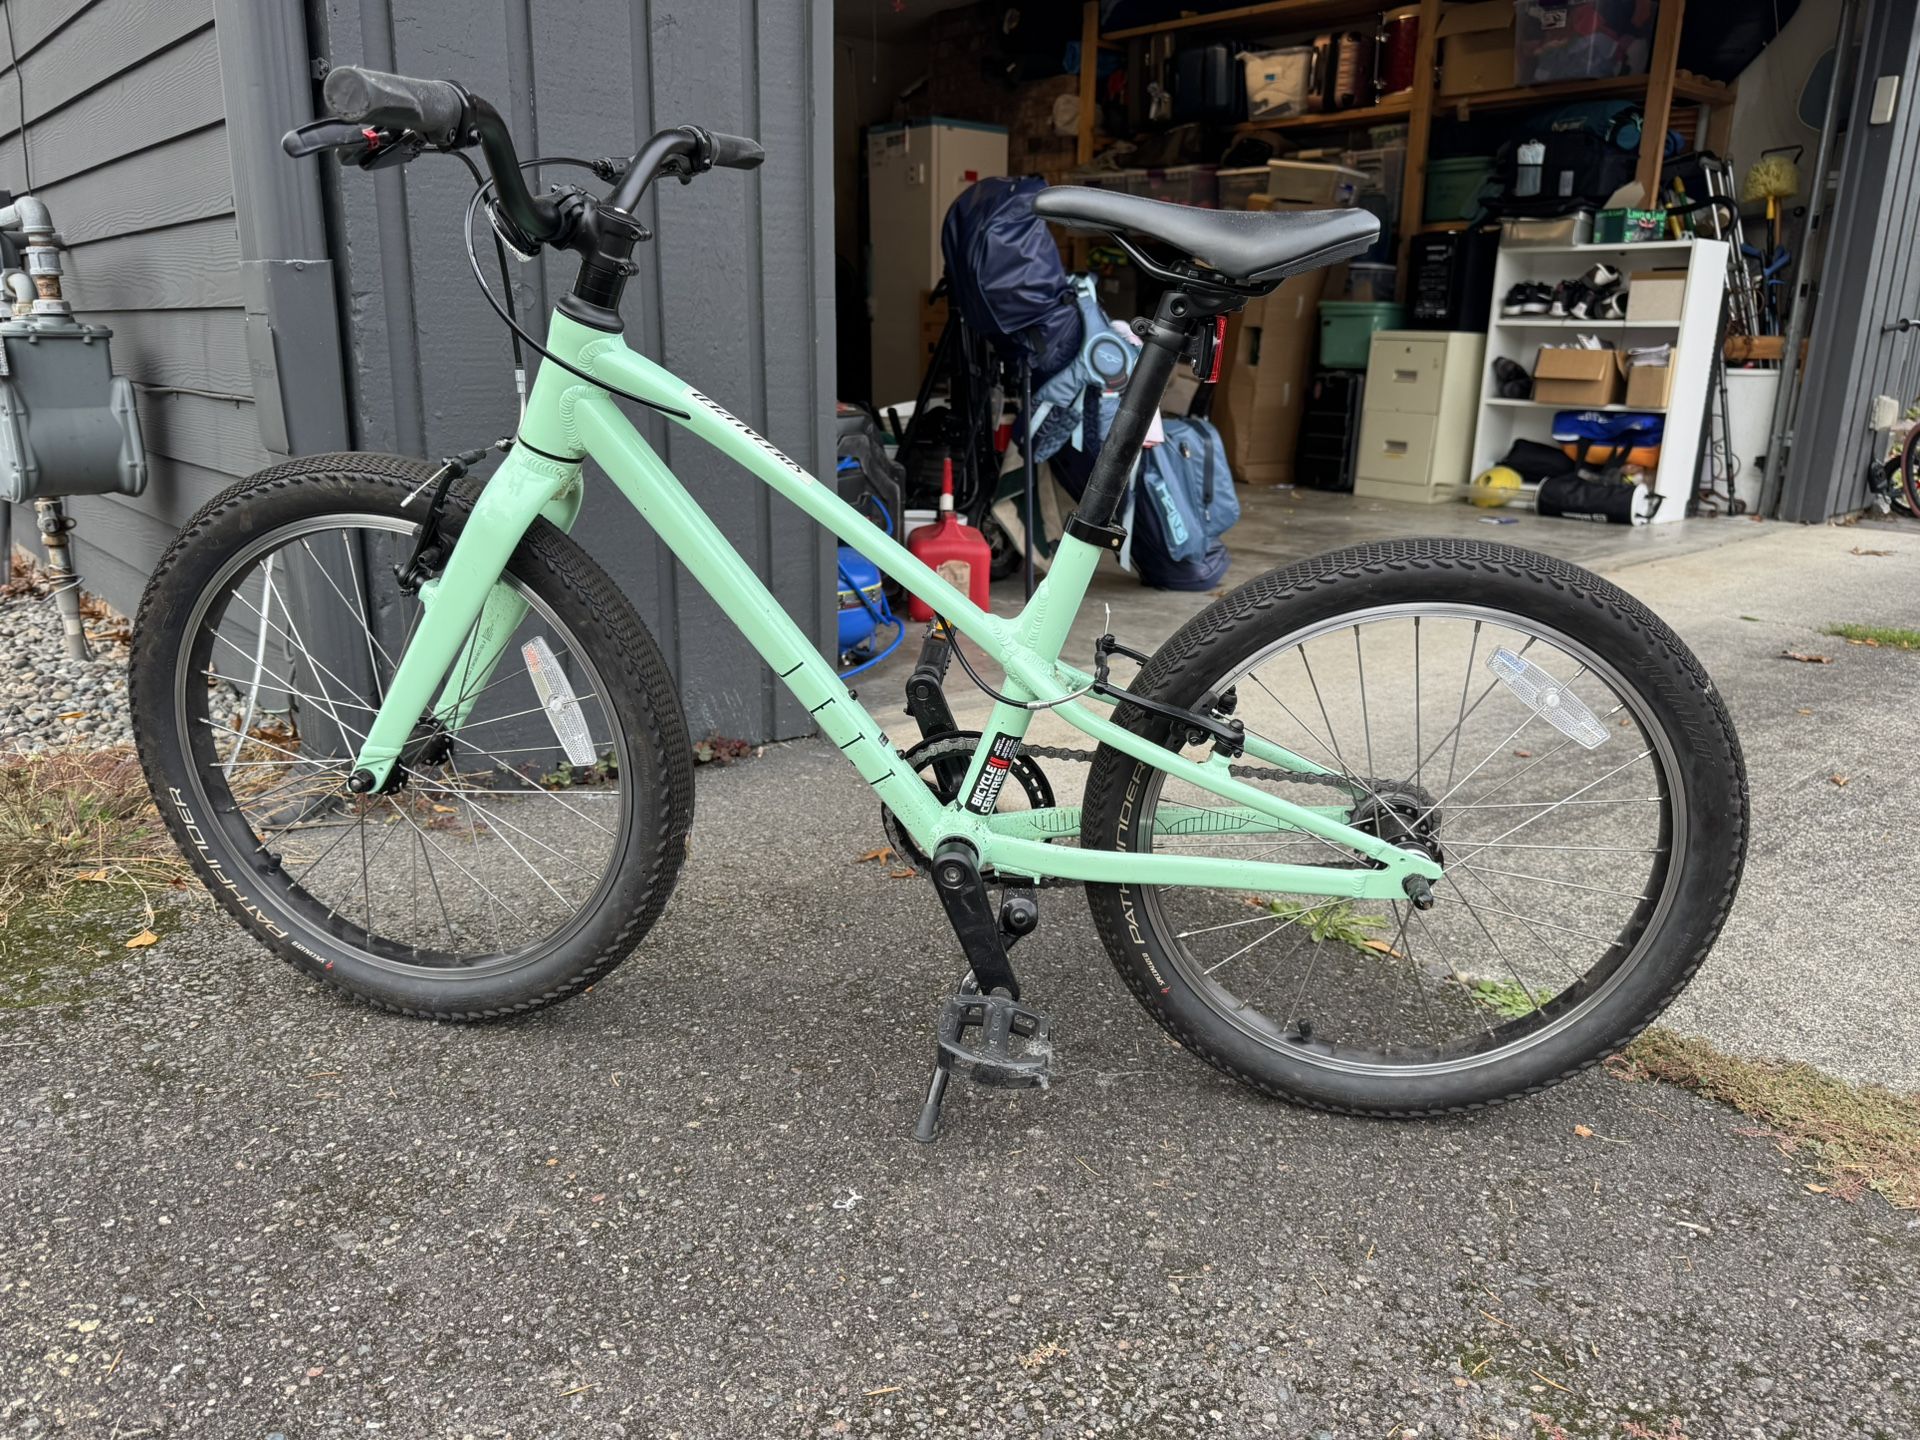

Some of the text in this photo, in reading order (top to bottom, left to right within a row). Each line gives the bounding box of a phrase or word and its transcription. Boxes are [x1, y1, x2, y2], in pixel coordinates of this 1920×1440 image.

[691, 392, 803, 474] SPECIALIZED
[970, 763, 999, 807] BICYCLE
[980, 767, 1008, 814] CENTRES
[168, 787, 289, 940] PATHFINDER
[1141, 952, 1167, 986] SPECIALIZED
